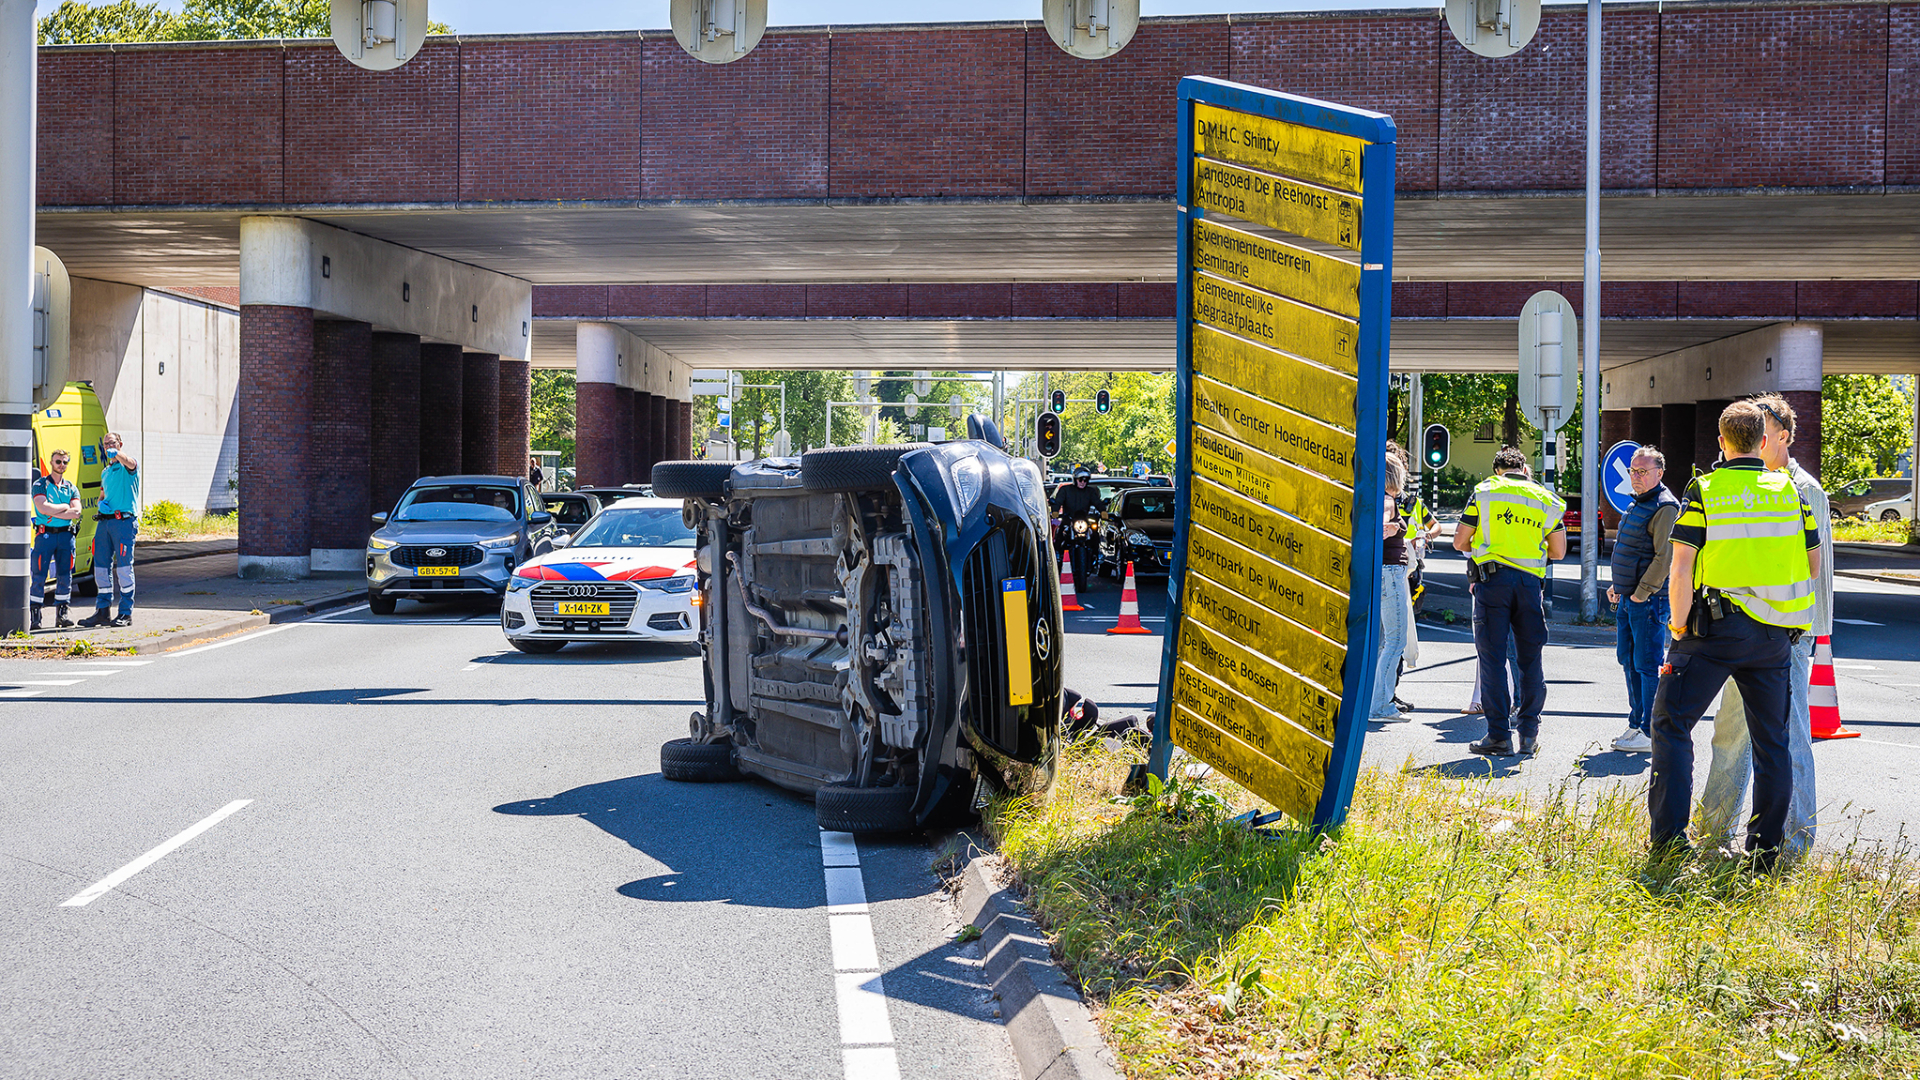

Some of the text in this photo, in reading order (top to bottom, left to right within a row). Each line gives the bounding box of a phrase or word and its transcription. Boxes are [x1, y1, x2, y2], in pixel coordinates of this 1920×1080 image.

[1197, 119, 1280, 157] D.M.H.C. Shinty
[1197, 161, 1329, 211] Landgoed De Reehorst
[1197, 186, 1246, 214] Antropia
[1197, 225, 1312, 274] Evenemententerrein
[1197, 249, 1249, 279] Seminarie
[1196, 275, 1274, 316] Gemeentelijke
[1196, 301, 1274, 340] begraafplaats
[1195, 391, 1348, 467] Health Center Hoenderdaal
[1195, 430, 1244, 465] Heidetuin
[1195, 453, 1233, 480] Museum
[1235, 466, 1271, 491] Militaire
[1237, 479, 1269, 502] Traditie
[1731, 488, 1795, 509] POLITIE
[1194, 492, 1304, 555] Zwembad De Zwoer
[1496, 507, 1542, 529] POLITIE
[1192, 539, 1304, 607] Sportpark De Woerd
[564, 603, 603, 614] X-141-ZK
[1188, 588, 1261, 637] KART-CIRCUIT
[1184, 631, 1279, 696] De Bergse Bossen
[1179, 666, 1236, 712] Restaurant
[1174, 707, 1221, 747] Landgoed
[1179, 686, 1265, 750] Klein Zwitserland
[1175, 727, 1254, 786] Kraaybeekerhof
